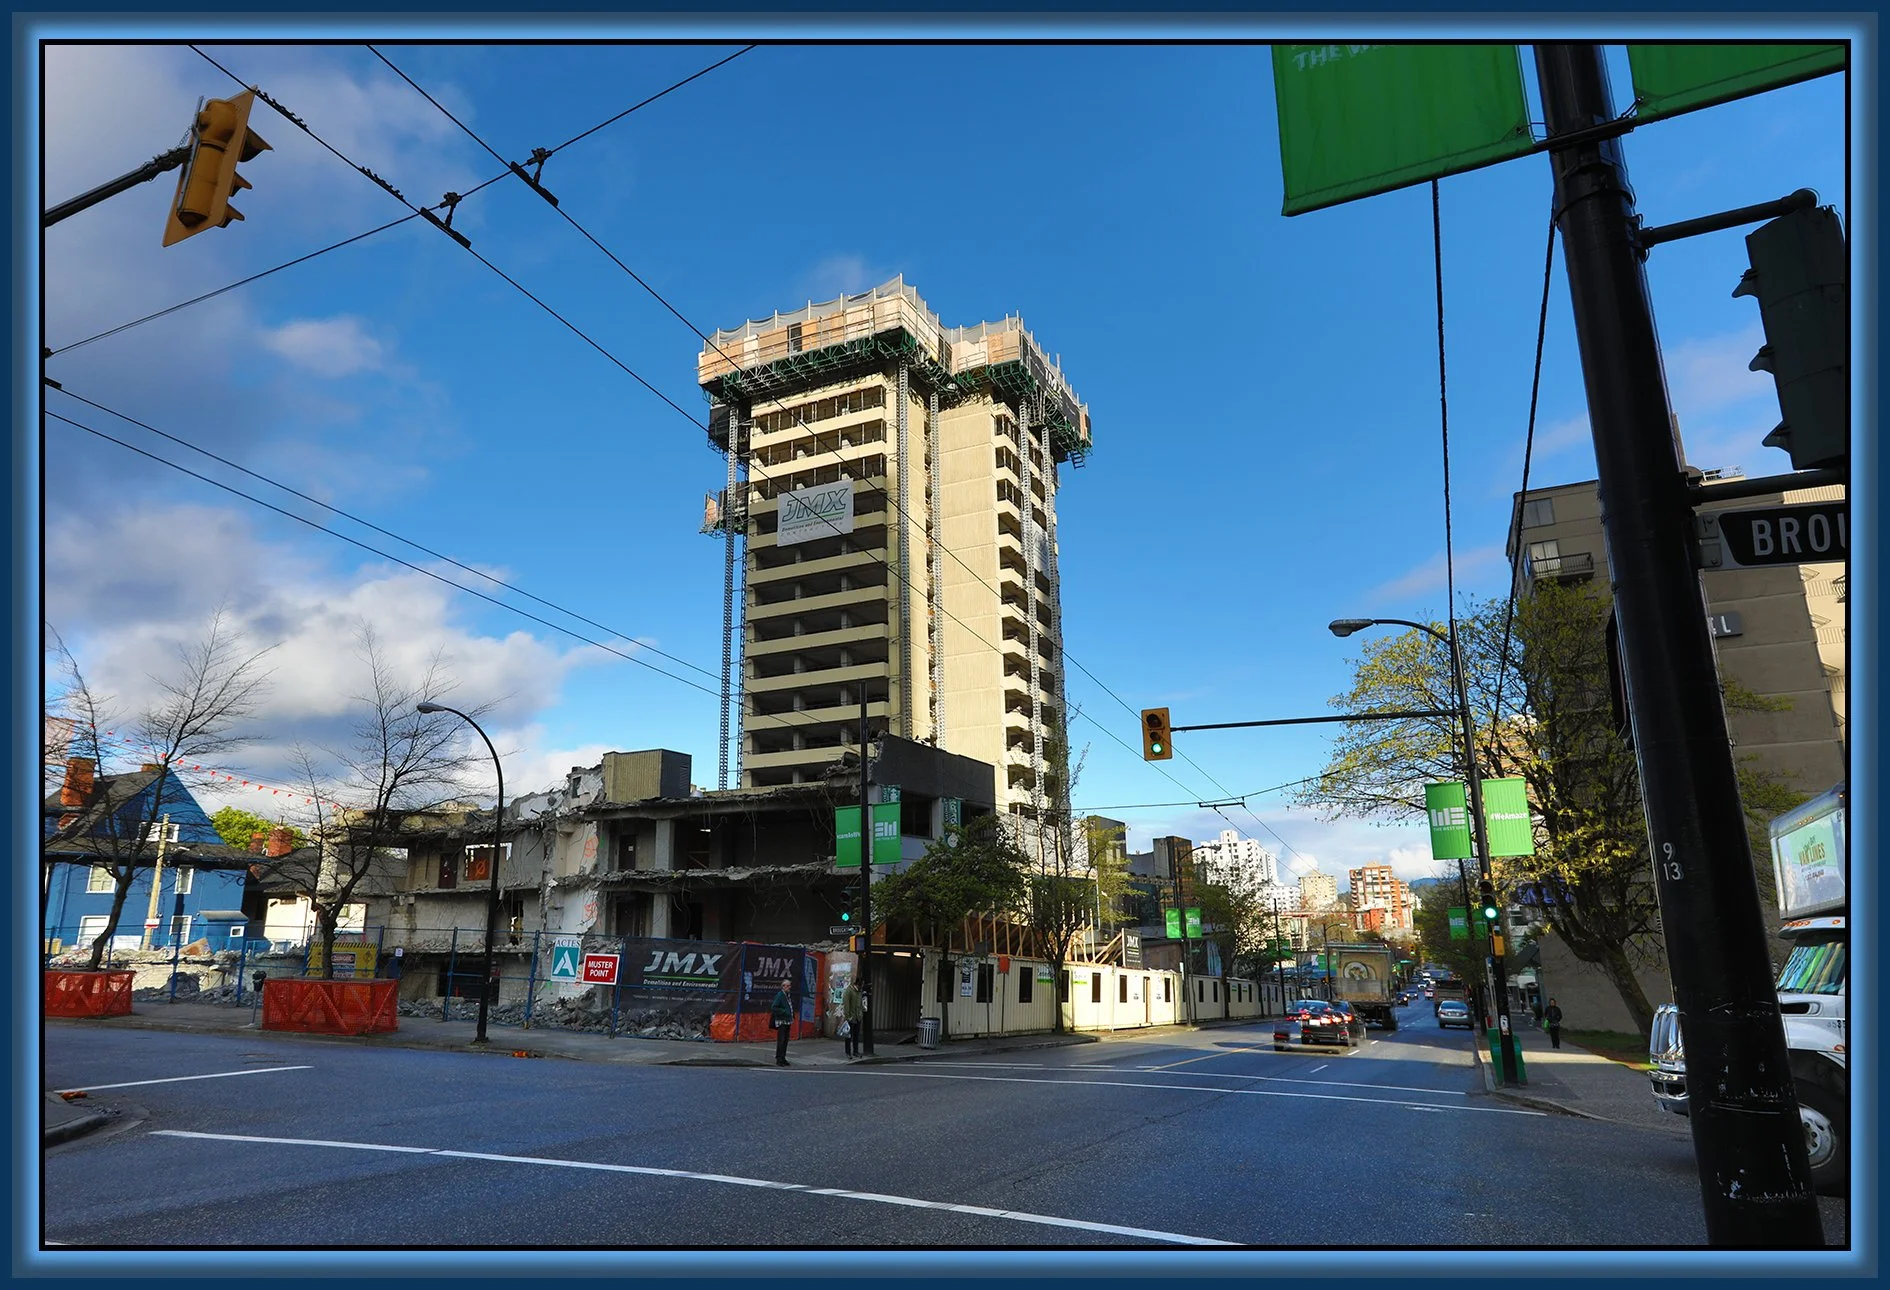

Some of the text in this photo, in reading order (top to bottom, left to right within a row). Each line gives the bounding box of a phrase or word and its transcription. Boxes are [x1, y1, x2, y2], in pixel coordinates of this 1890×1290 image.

[1292, 46, 1342, 72] THE
[782, 488, 849, 522] JMX
[1662, 842, 1673, 860] 9
[1663, 861, 1682, 880] 13
[588, 960, 613, 969] MUSTER
[643, 950, 723, 975] JMX
[753, 956, 794, 977] JMX
[590, 969, 609, 978] POINT
[643, 978, 671, 987] Demolition
[682, 980, 719, 989] Environmental
